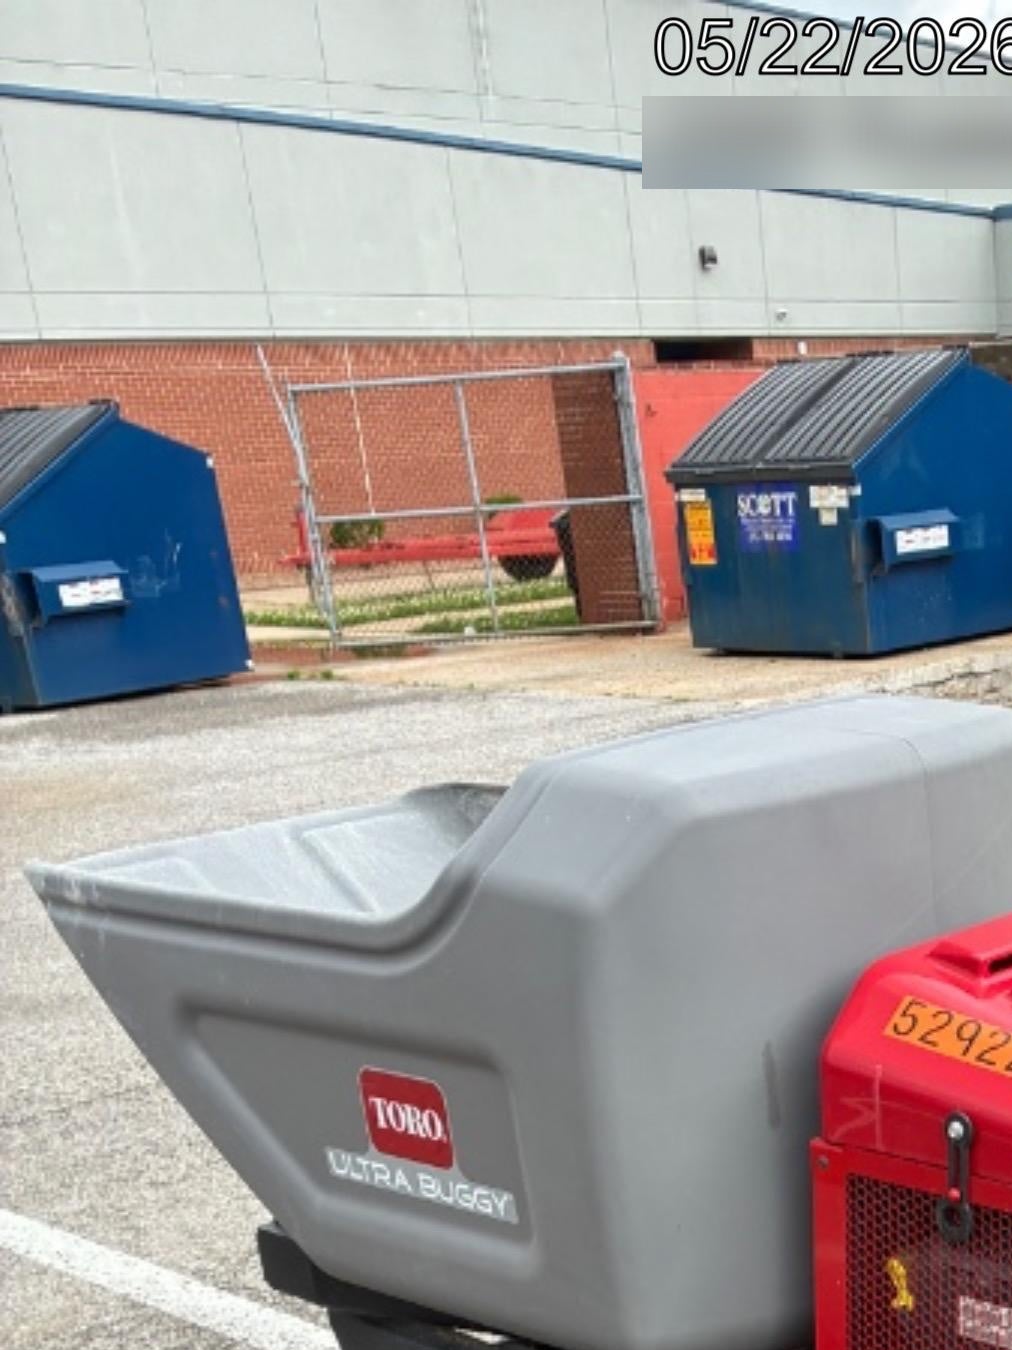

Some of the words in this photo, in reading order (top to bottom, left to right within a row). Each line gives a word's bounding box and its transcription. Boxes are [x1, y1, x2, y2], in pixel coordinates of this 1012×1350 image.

[737, 491, 797, 517] SCOTT
[368, 1097, 446, 1141] TORO
[326, 1149, 413, 1193] ULTRA
[416, 1172, 510, 1217] BUGGY
